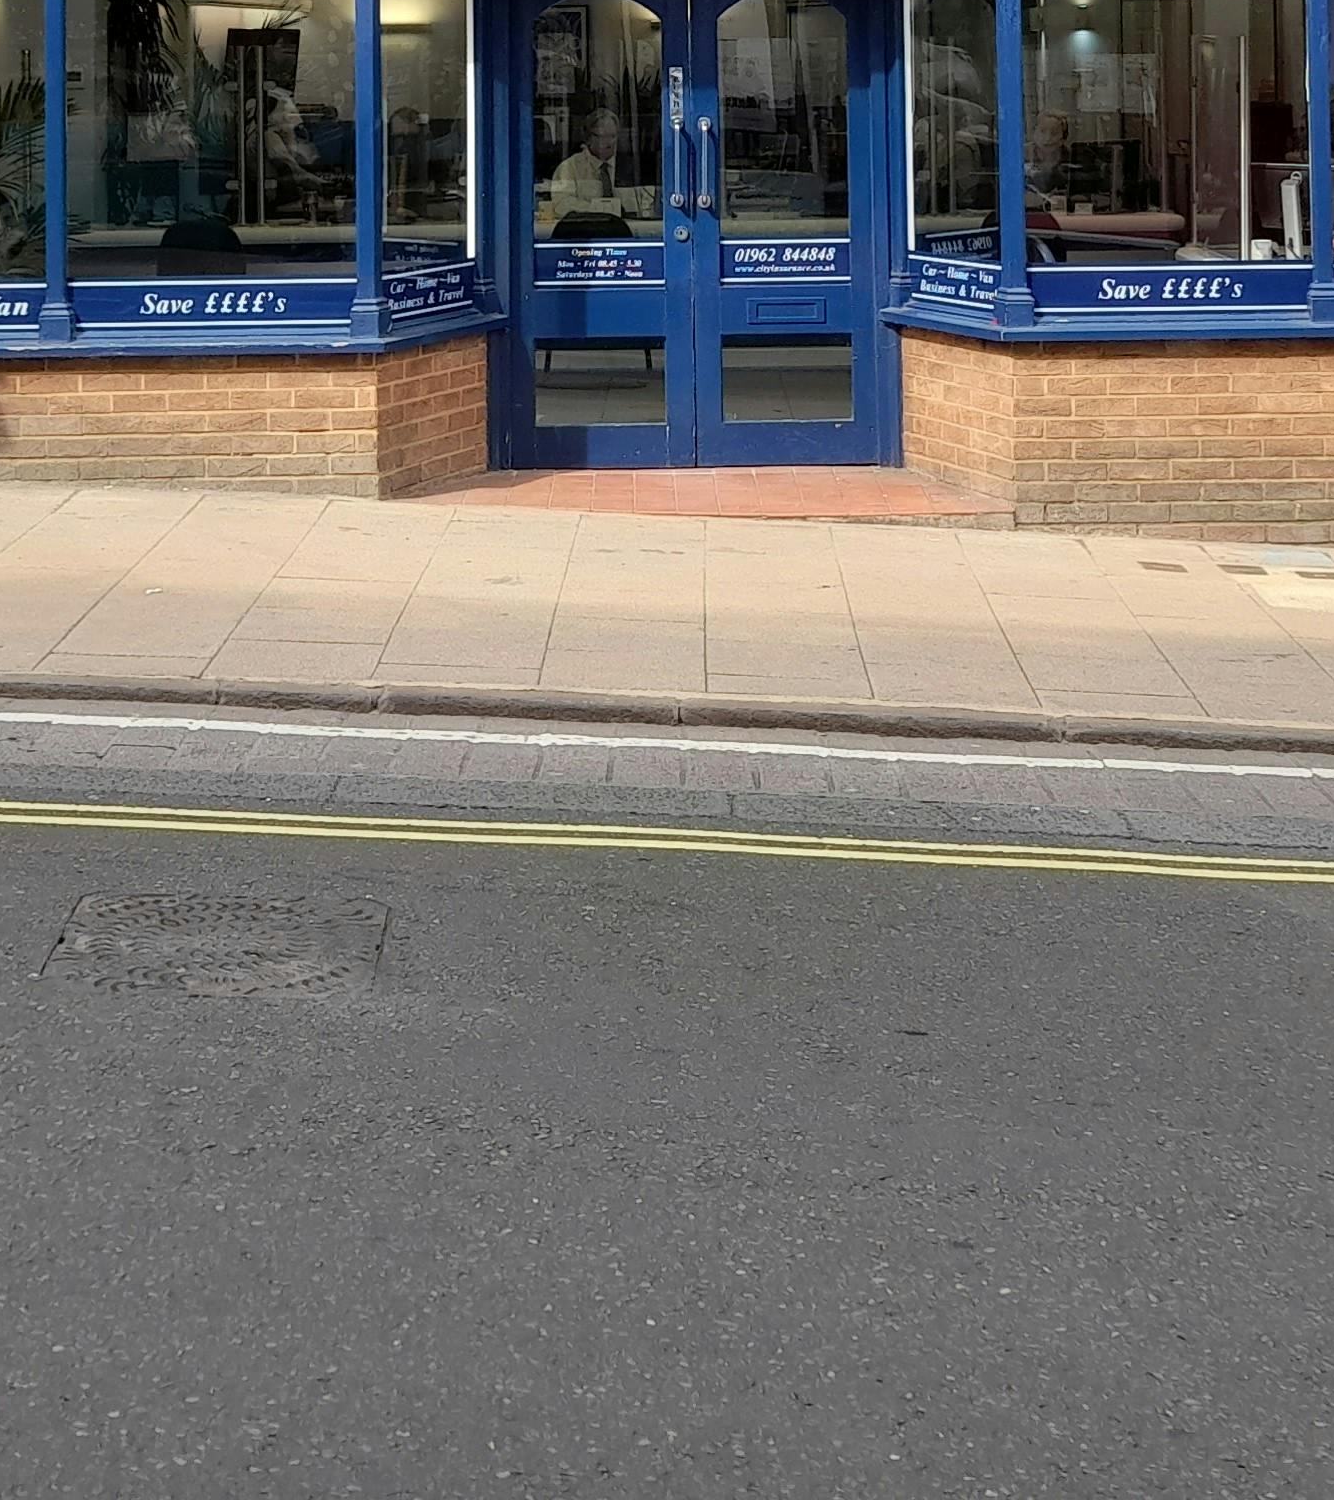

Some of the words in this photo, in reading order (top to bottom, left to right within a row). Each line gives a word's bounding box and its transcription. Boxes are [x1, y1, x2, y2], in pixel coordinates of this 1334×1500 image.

[571, 248, 603, 258] Opening
[606, 248, 628, 256] Times
[734, 248, 777, 263] 01962
[782, 247, 837, 261] 844848
[557, 260, 575, 269] Mon
[583, 259, 596, 268] Fri
[734, 263, 836, 274] www.cityinsurance.co.uk
[556, 270, 593, 279] Saturdays
[624, 269, 644, 279] Noon
[922, 263, 937, 276] Car
[947, 266, 970, 280] Home
[979, 270, 994, 284] Van
[390, 281, 406, 294] Car
[415, 277, 438, 290] Home
[447, 272, 461, 285] Van
[920, 279, 956, 296] Business
[958, 284, 966, 297] &
[1098, 278, 1152, 301] Save
[139, 293, 194, 315] Save
[387, 295, 425, 311] Business
[427, 291, 435, 304] &
[438, 285, 464, 302] Travel
